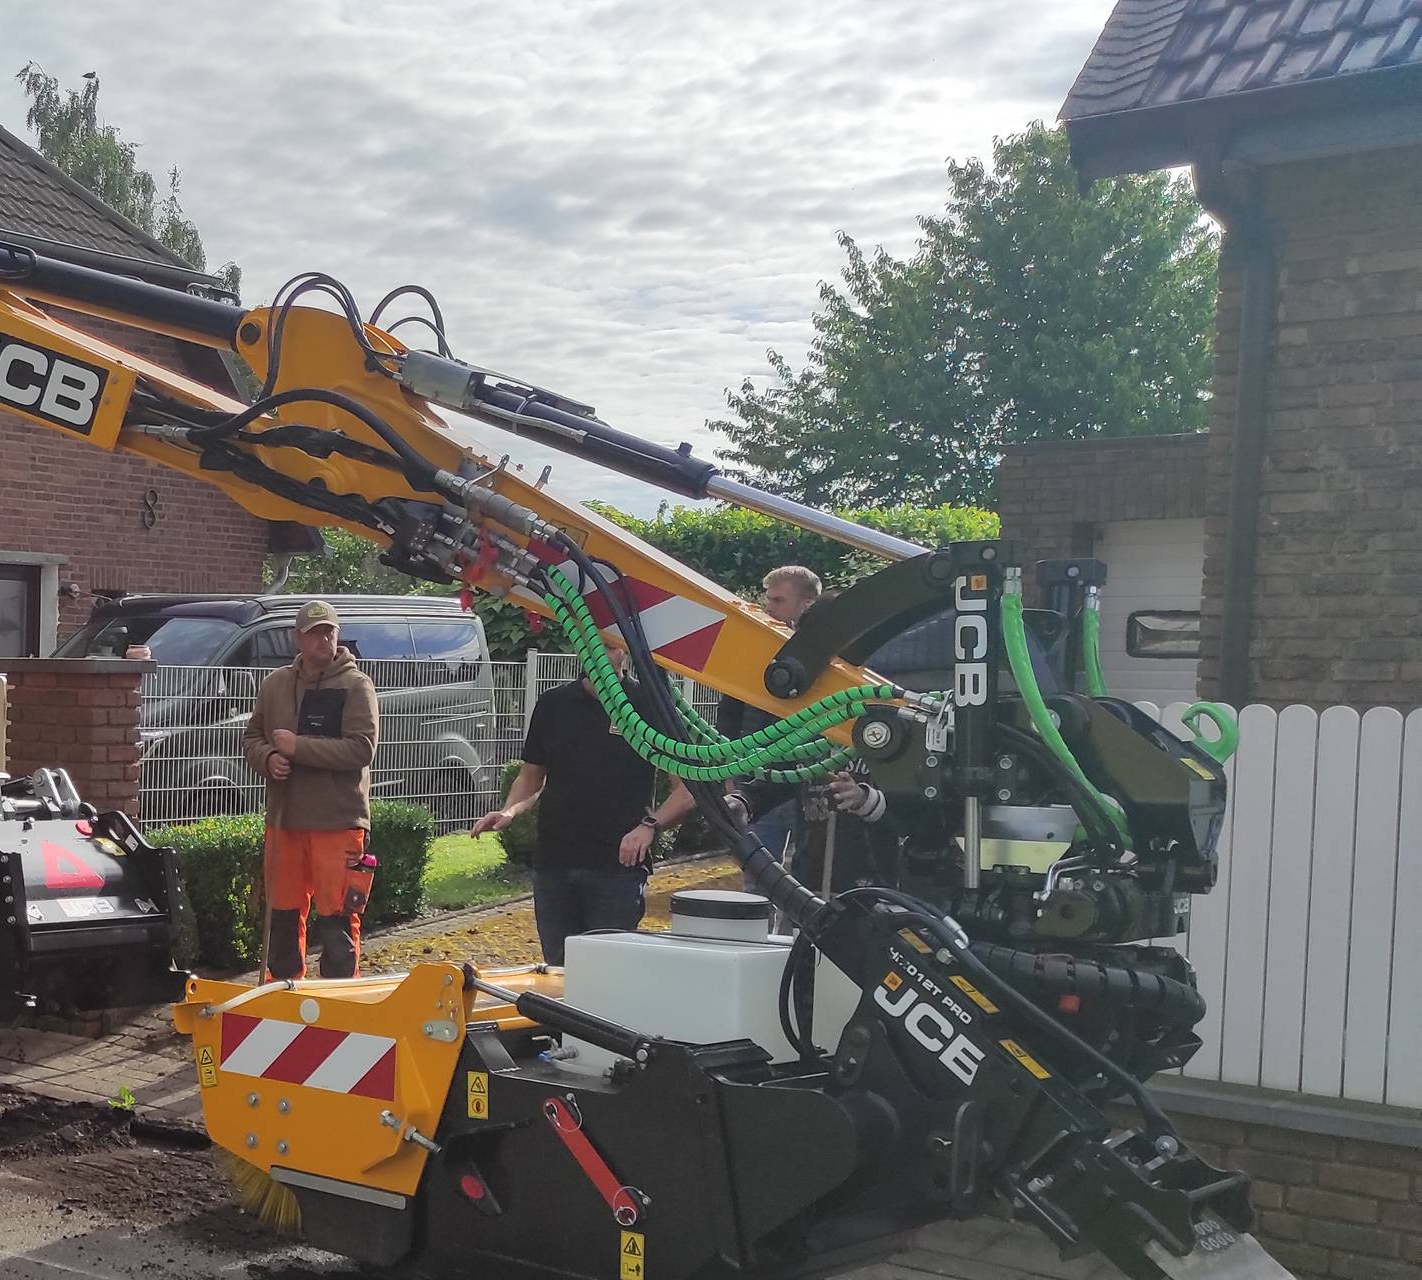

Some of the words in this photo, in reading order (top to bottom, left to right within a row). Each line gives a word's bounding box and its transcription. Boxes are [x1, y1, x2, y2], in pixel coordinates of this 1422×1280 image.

[145, 488, 158, 529] 8
[955, 575, 988, 707] JCB
[941, 996, 973, 1025] PRO
